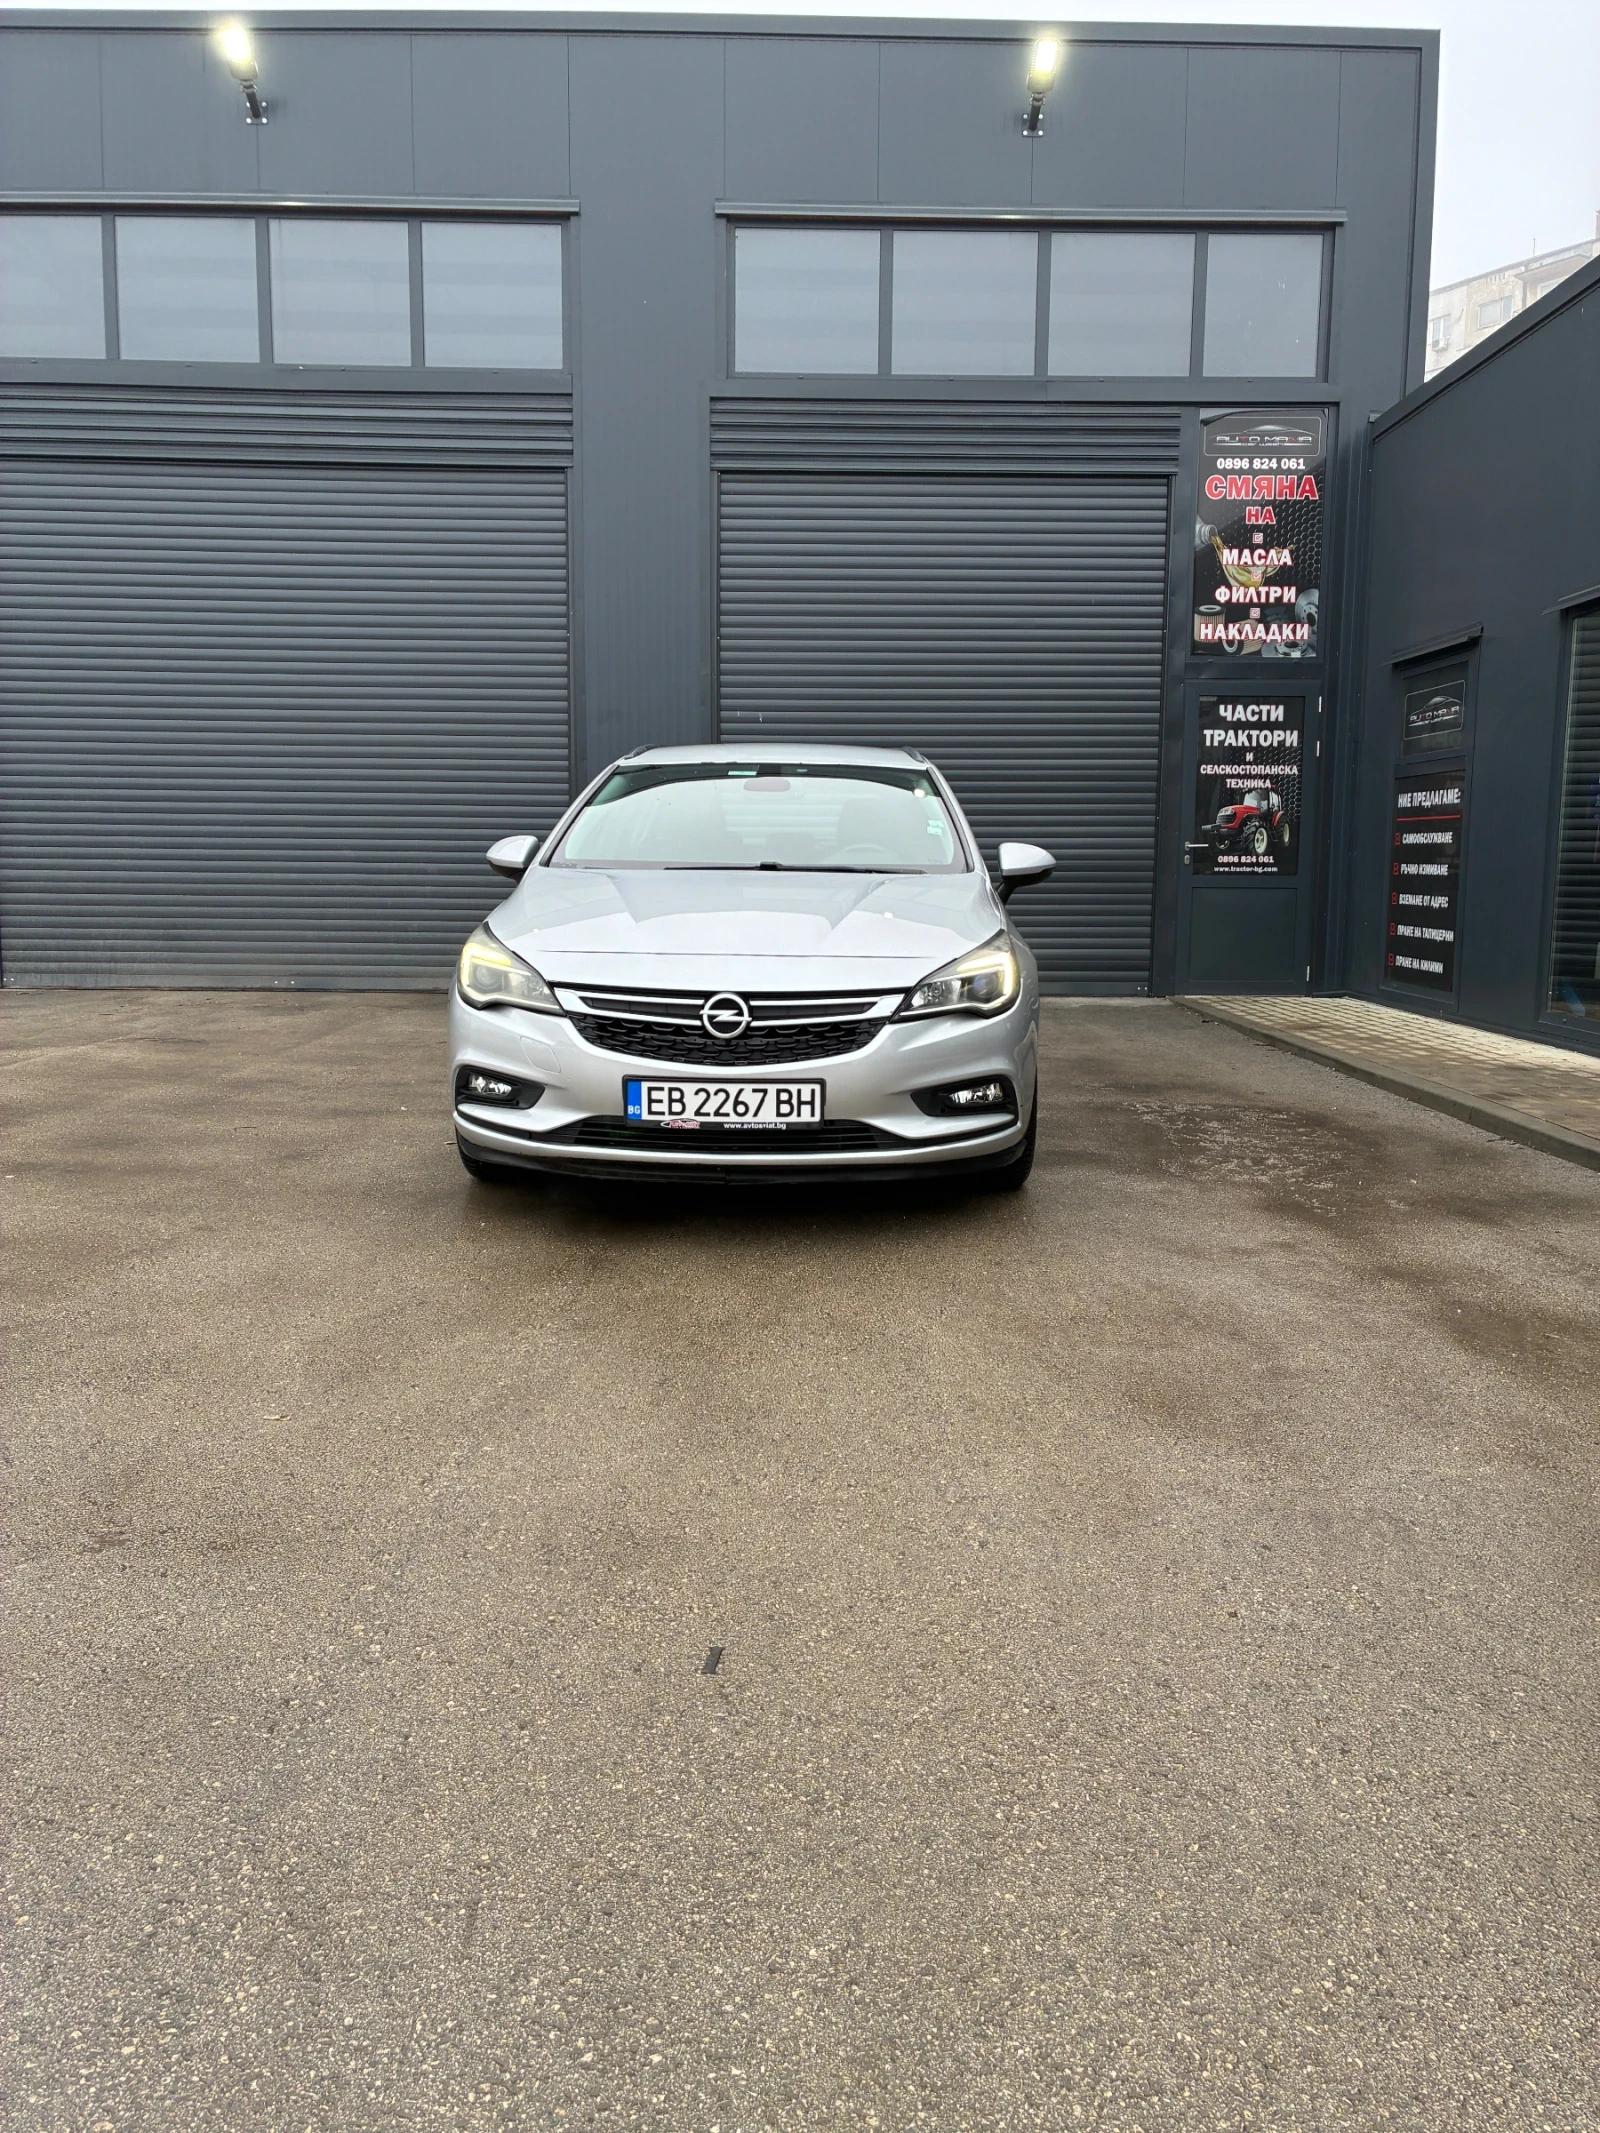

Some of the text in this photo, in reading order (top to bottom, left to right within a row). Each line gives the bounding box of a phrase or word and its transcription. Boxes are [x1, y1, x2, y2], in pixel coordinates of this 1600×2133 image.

[1216, 457, 1306, 470] 0896 824 061
[1205, 474, 1319, 500] СМЯНА
[1246, 506, 1276, 525] НА
[1221, 548, 1293, 567] МАСЛА
[1214, 585, 1297, 604] ФИЛТРИ
[1200, 622, 1310, 643] НАКЛАДКИ
[1218, 704, 1285, 722] ЧАСТИ
[1203, 729, 1299, 748] ТРАКТОРИ
[1246, 752, 1254, 763] И
[1200, 764, 1299, 776] СЕЛСКОСТОПАНСКА
[1225, 778, 1272, 789] ТЕХНИКА
[1398, 787, 1462, 809] НИЕ ПРЕДЛАГАМЕ:
[1402, 831, 1454, 845] САМООБСЛУЖВАНЕ
[1217, 855, 1275, 863] 0896 824 061
[1213, 865, 1278, 873] www.tractor-bg.com
[1400, 863, 1449, 876] РЪЧНО ИЗМИВАНЕ
[1399, 893, 1449, 909] ВЗЕМАНЕ ОТ АДРЕС
[1397, 924, 1414, 938] ПРАНЕ
[1414, 926, 1422, 938] НА
[1395, 954, 1444, 974] ПРАНЕ НА КИЛИМИ
[627, 1105, 641, 1115] BG
[647, 1086, 816, 1118] EB 2267 BH
